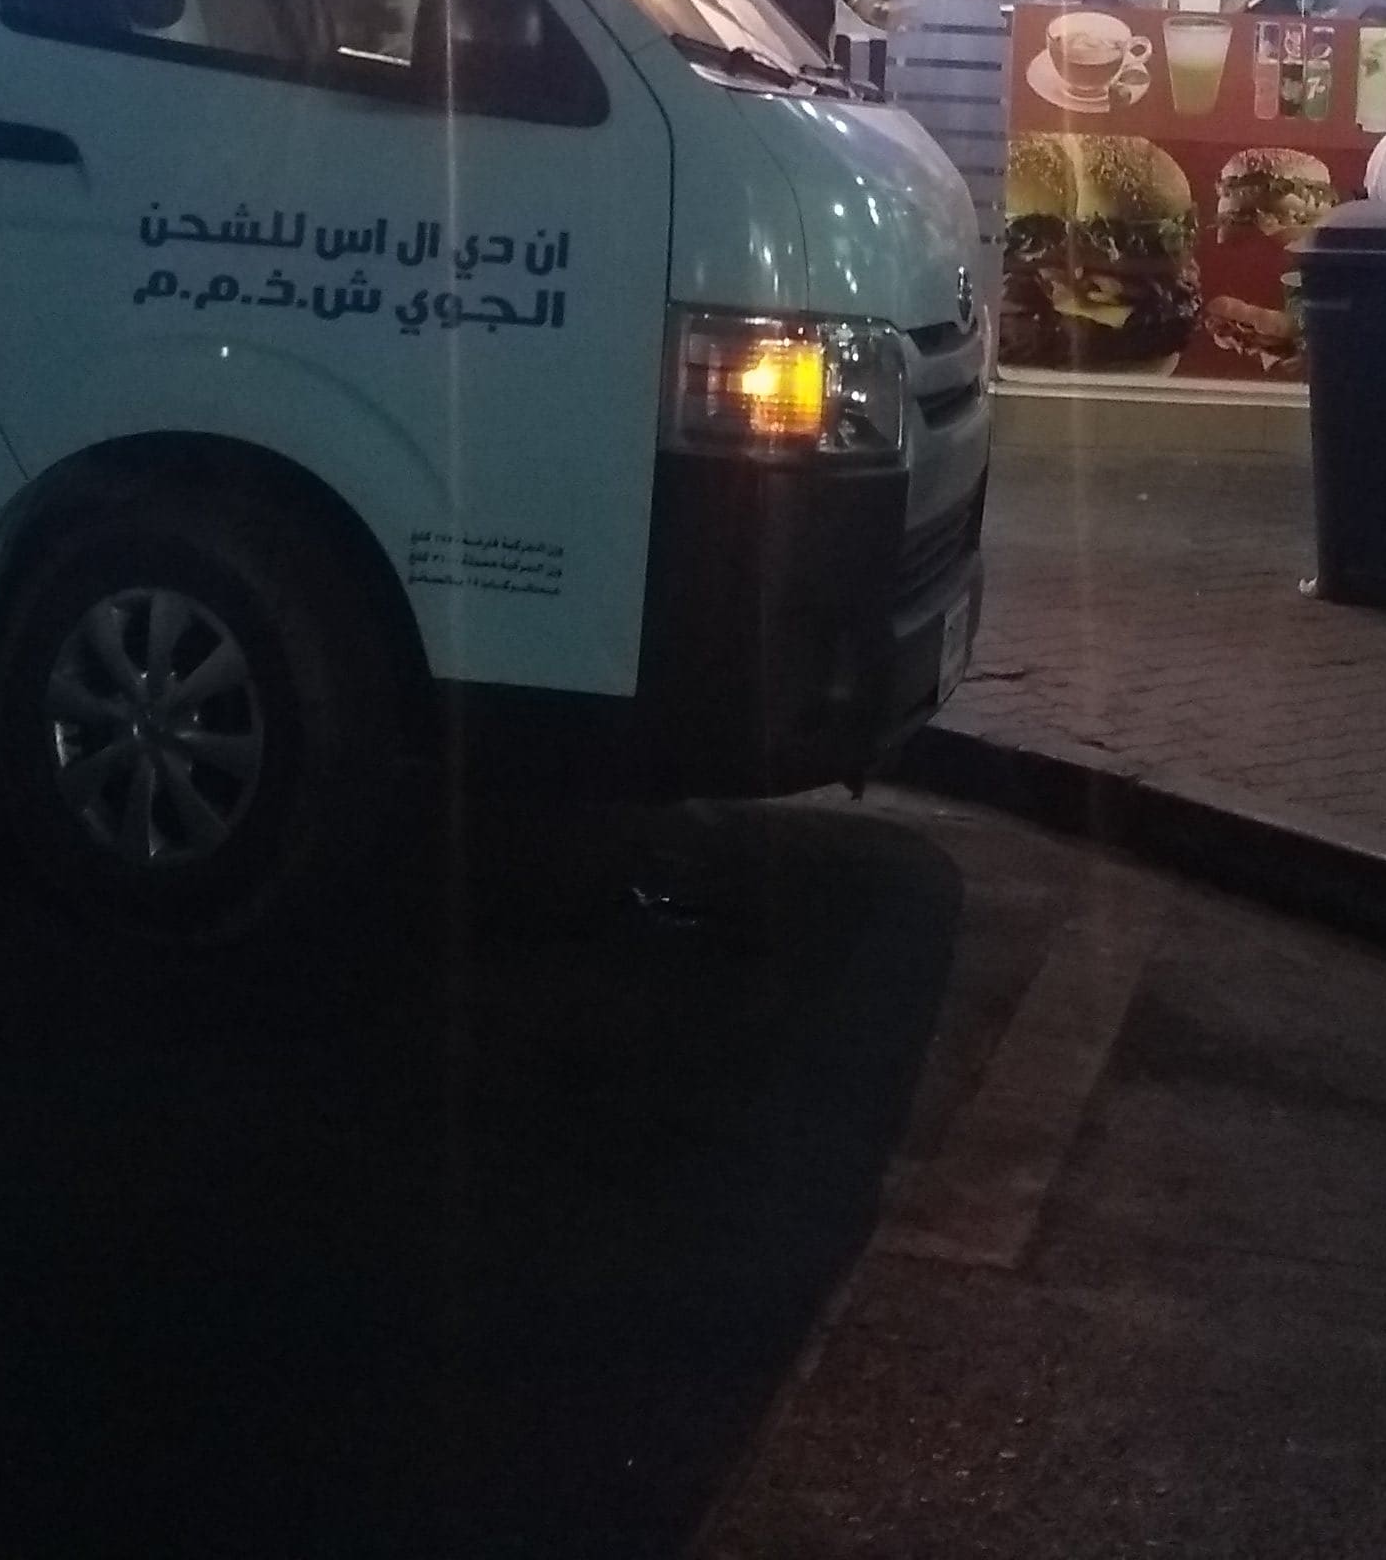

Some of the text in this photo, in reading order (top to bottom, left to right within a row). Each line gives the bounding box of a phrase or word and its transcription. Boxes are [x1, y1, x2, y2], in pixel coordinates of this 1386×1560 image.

[139, 201, 306, 249] للشحن
[315, 217, 388, 261] اس
[396, 220, 441, 267] ال
[394, 289, 566, 336] الجوي
